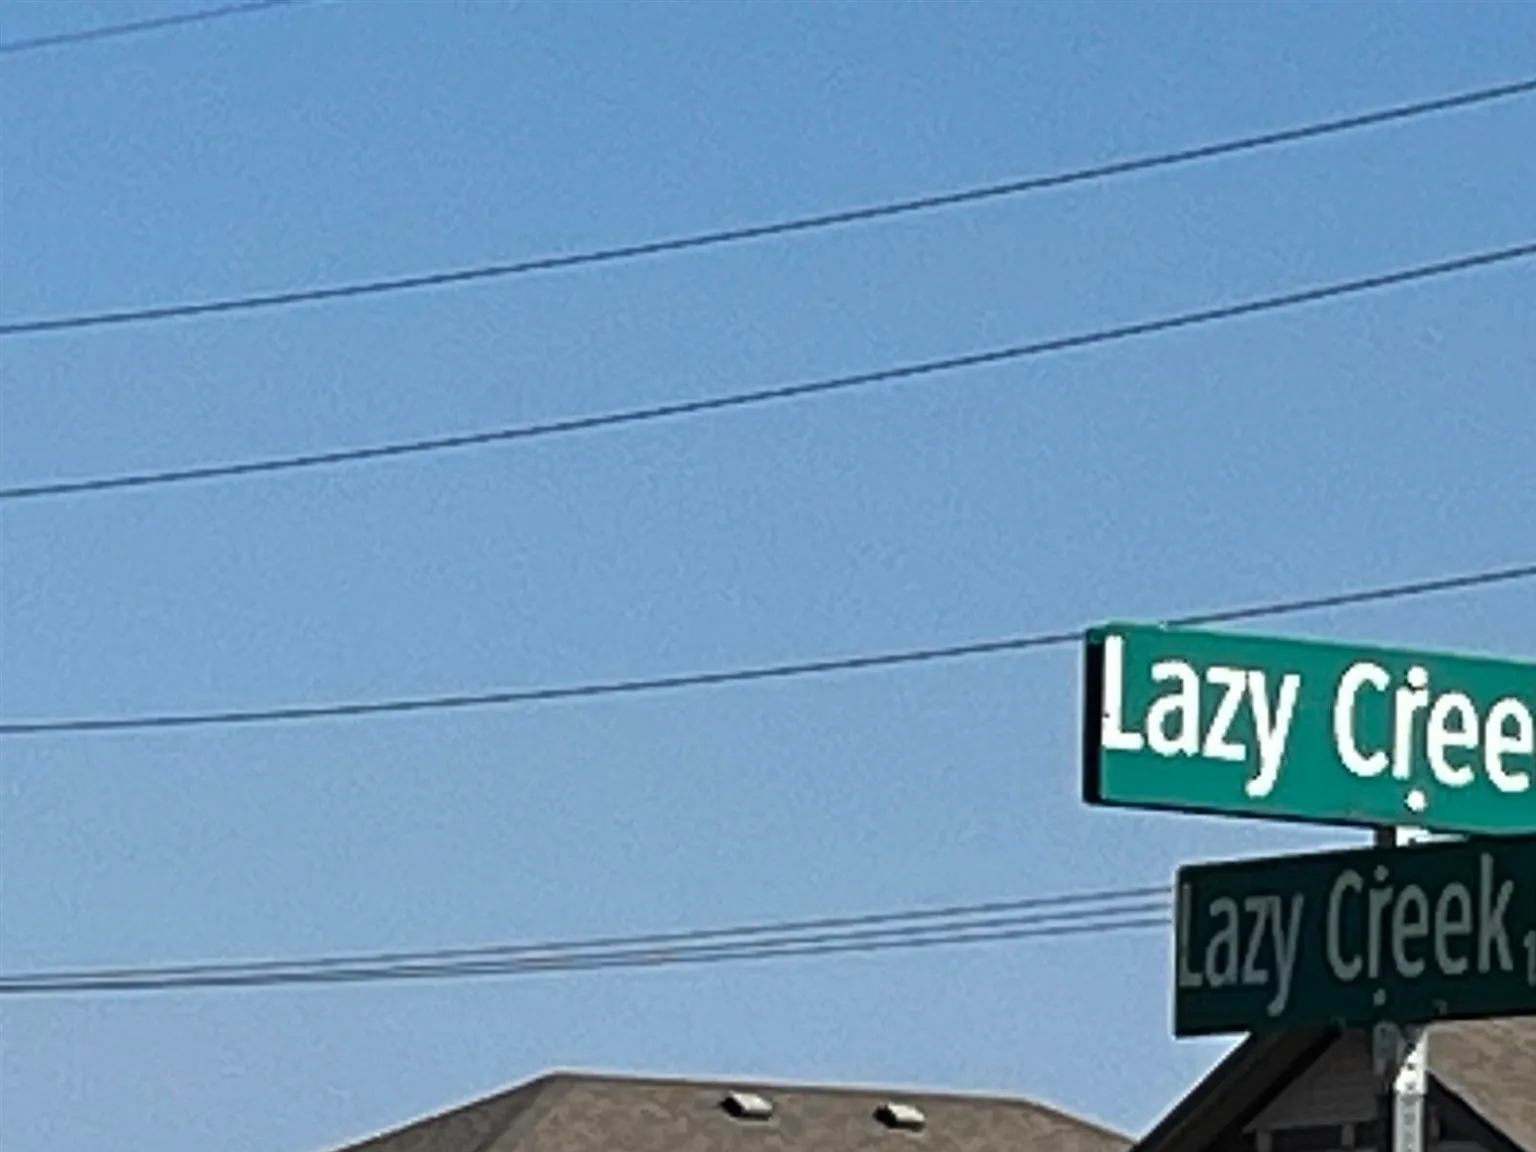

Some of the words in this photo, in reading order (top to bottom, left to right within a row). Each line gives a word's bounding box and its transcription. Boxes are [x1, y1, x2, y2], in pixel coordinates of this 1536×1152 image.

[1101, 635, 1301, 798] Lazy
[1179, 883, 1304, 1017] Lazy
[1326, 852, 1515, 982] Creek
